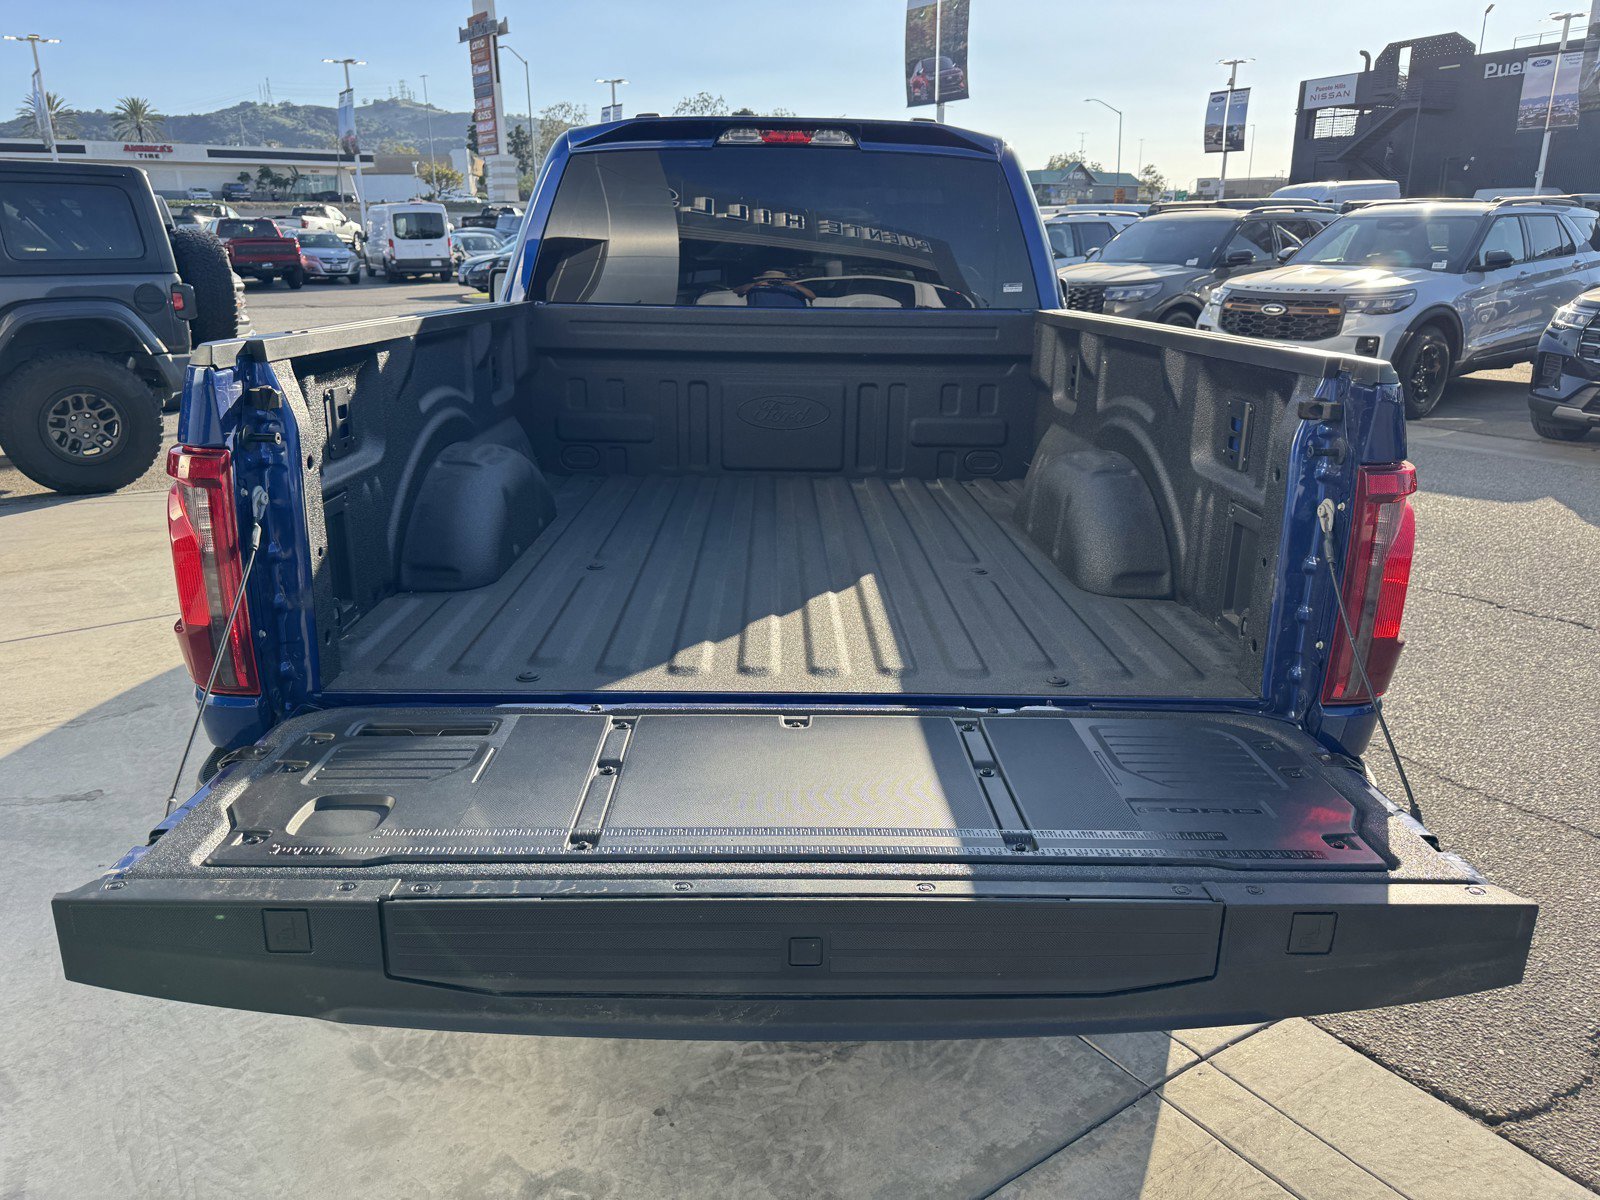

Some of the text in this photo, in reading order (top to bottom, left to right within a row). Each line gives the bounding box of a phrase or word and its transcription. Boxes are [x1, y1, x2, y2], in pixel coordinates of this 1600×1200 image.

[1309, 90, 1351, 102] NISSAN
[752, 399, 813, 424] Ford
[1137, 806, 1265, 815] FORD
